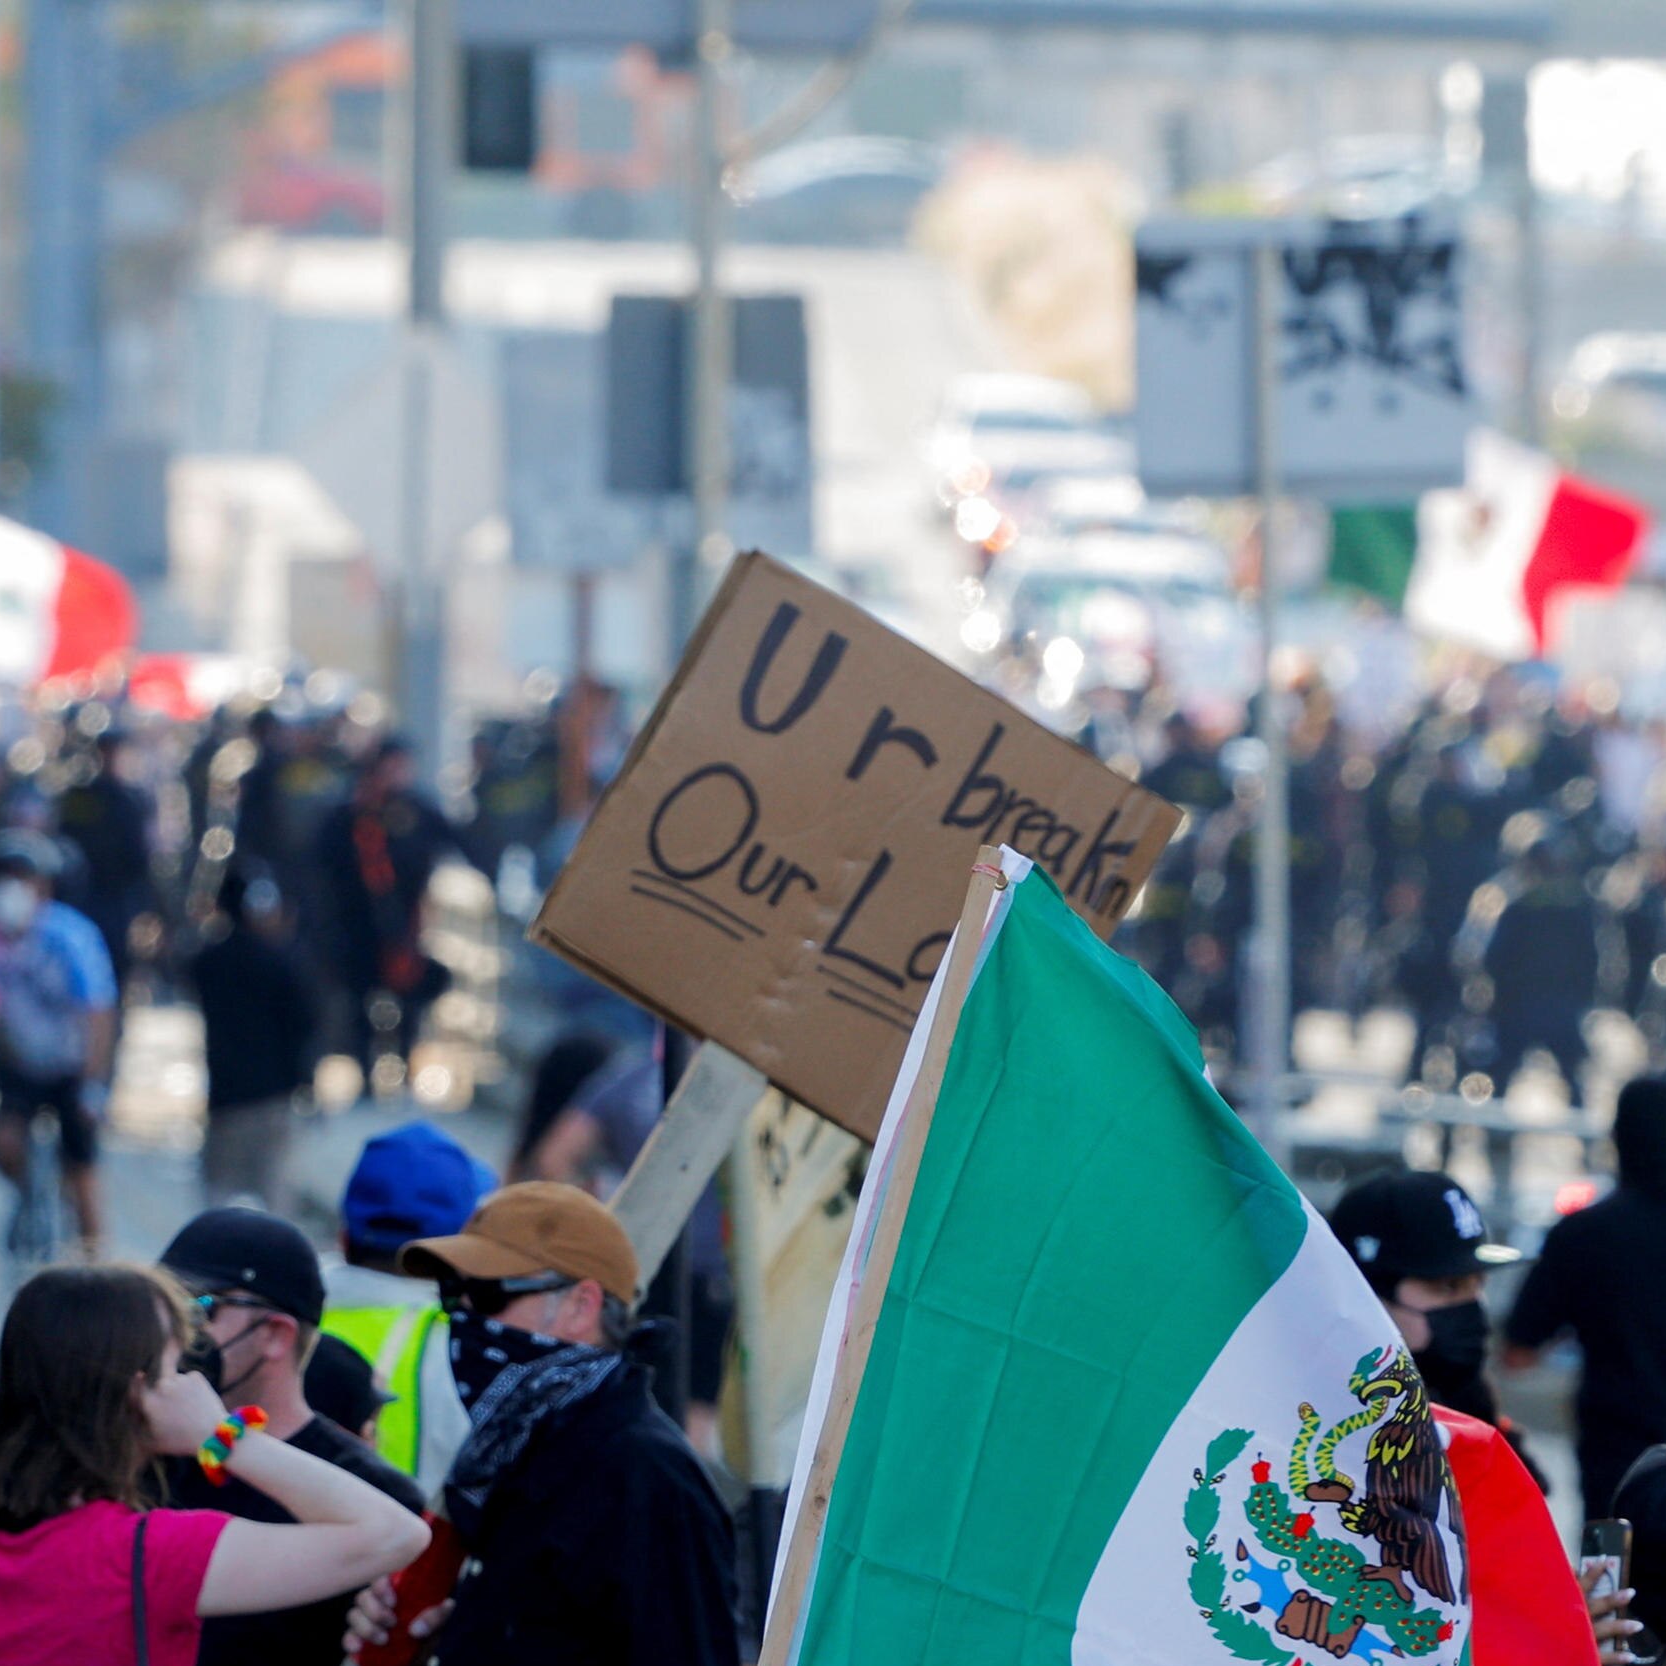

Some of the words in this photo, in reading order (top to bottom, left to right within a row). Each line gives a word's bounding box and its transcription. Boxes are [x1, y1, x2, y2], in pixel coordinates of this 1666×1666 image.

[740, 601, 849, 735] U
[845, 706, 939, 780] r
[647, 761, 819, 907] Our
